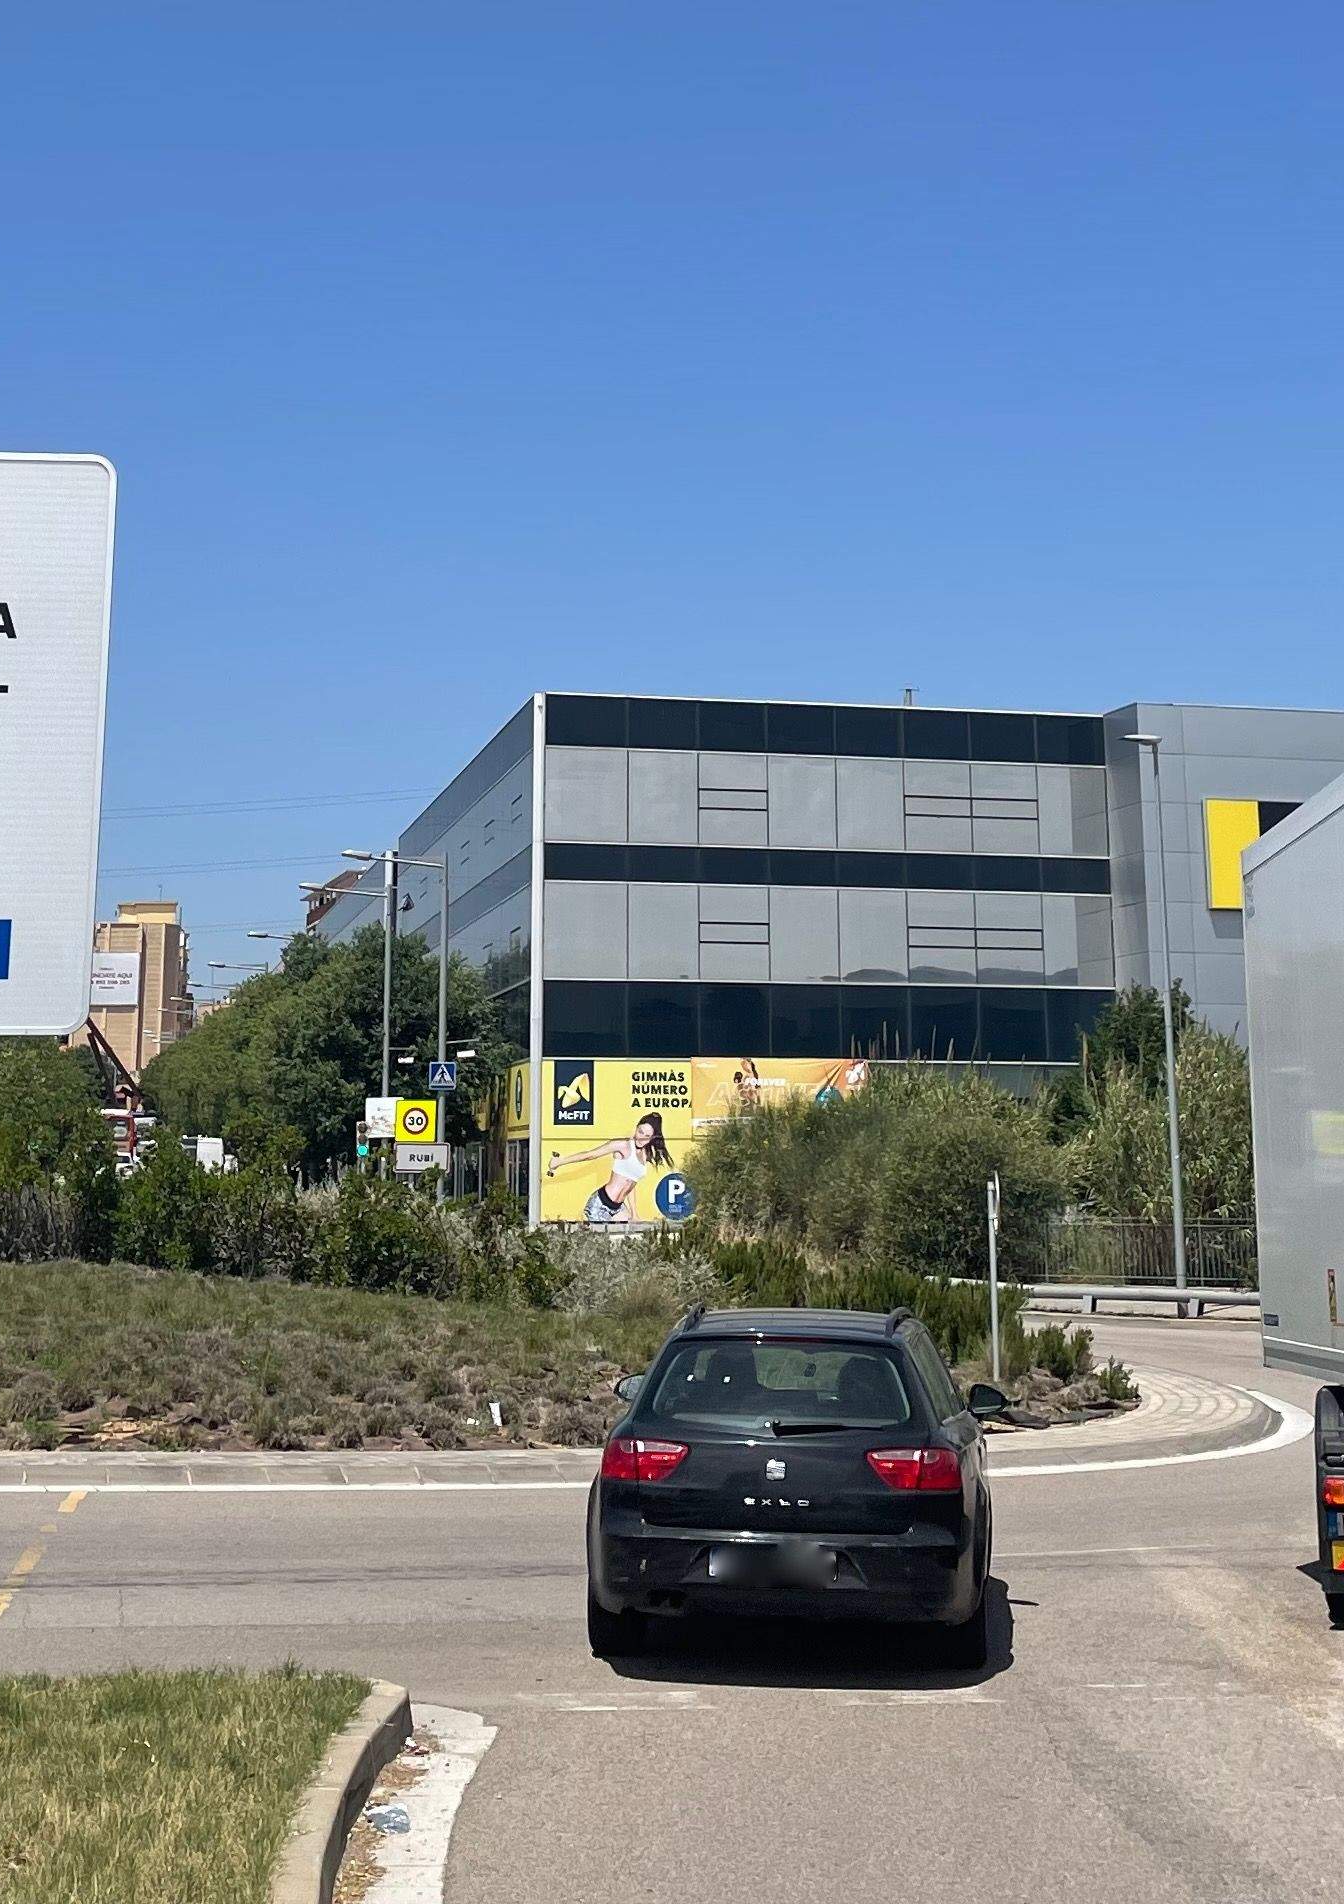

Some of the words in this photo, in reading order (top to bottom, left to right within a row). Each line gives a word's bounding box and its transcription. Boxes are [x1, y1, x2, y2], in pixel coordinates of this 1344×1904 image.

[632, 1069, 685, 1082] GIMNÀS
[632, 1082, 688, 1095] NÚMERO
[631, 1098, 641, 1108] A
[408, 1116, 424, 1126] 30
[558, 1110, 591, 1121] McFIT
[409, 1152, 434, 1162] RUBÍ
[668, 1179, 686, 1204] P
